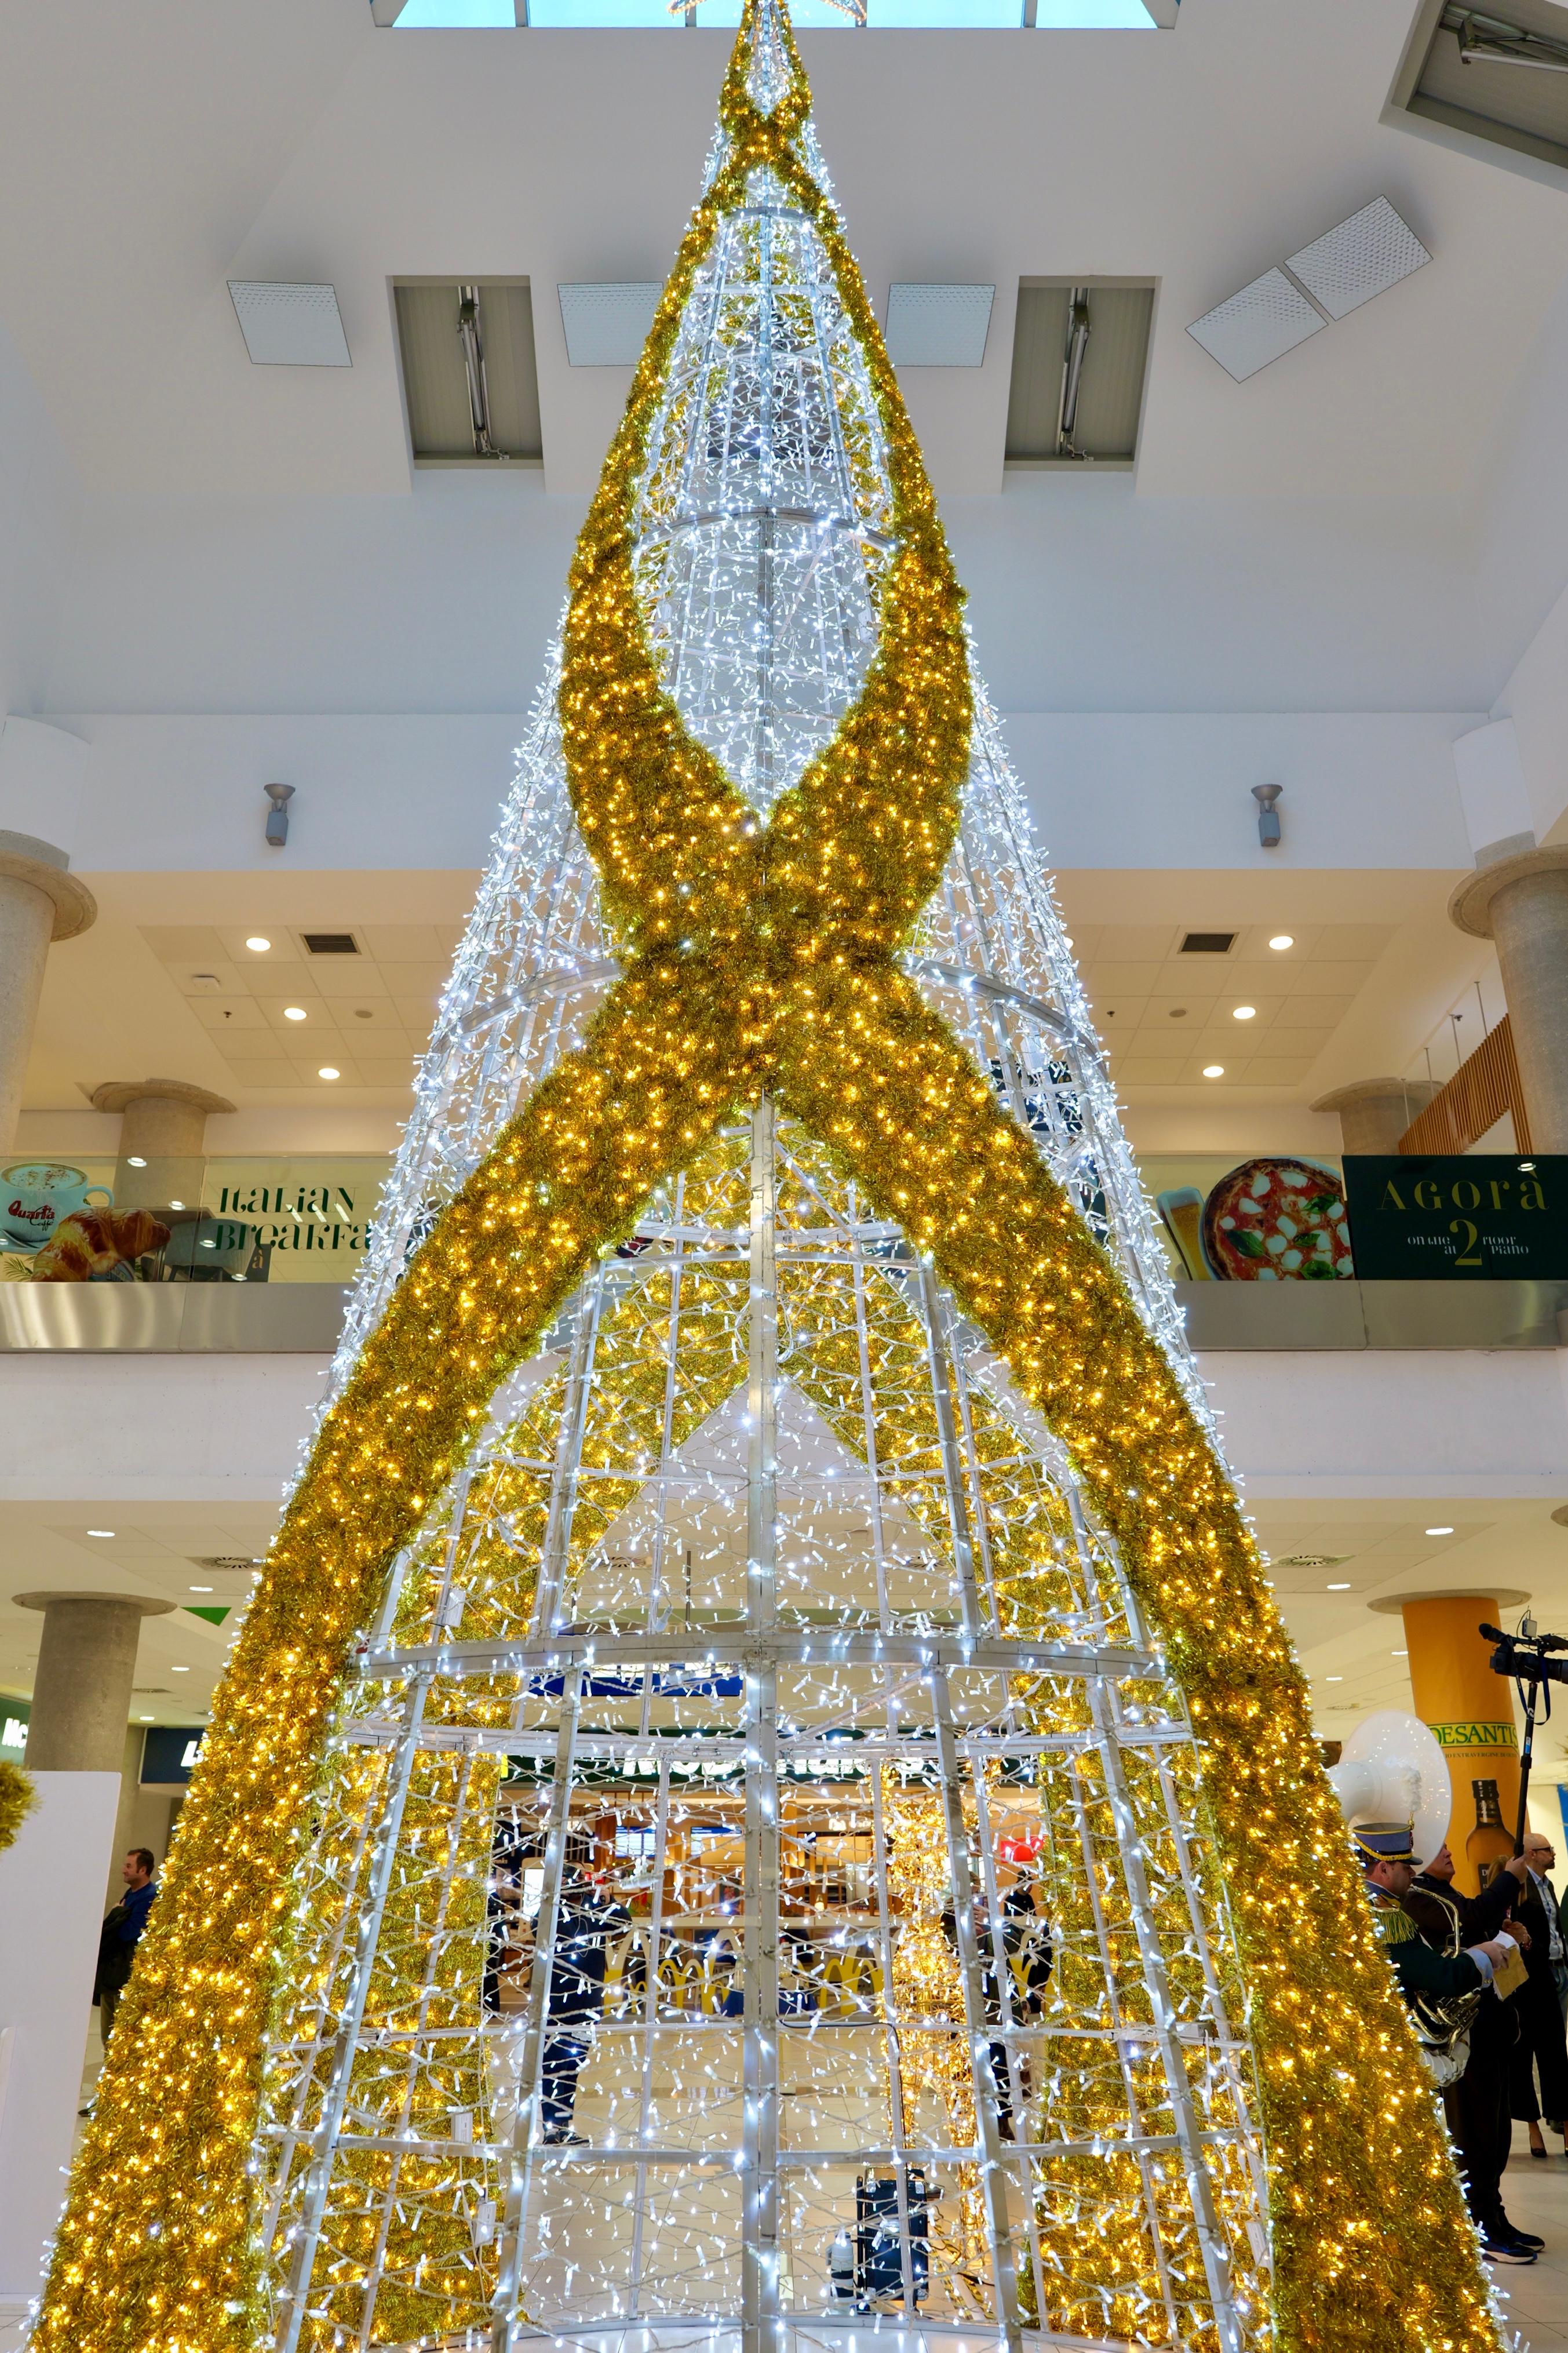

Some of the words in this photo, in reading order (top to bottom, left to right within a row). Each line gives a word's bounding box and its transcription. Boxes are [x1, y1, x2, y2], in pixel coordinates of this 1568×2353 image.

[8, 1200, 55, 1219] Quarta
[214, 1223, 371, 1250] BreaKFa
[1407, 1236, 1424, 1245] on
[1450, 1219, 1482, 1265] 2
[1492, 1245, 1529, 1255] Piano
[2, 1718, 28, 1748] Mc
